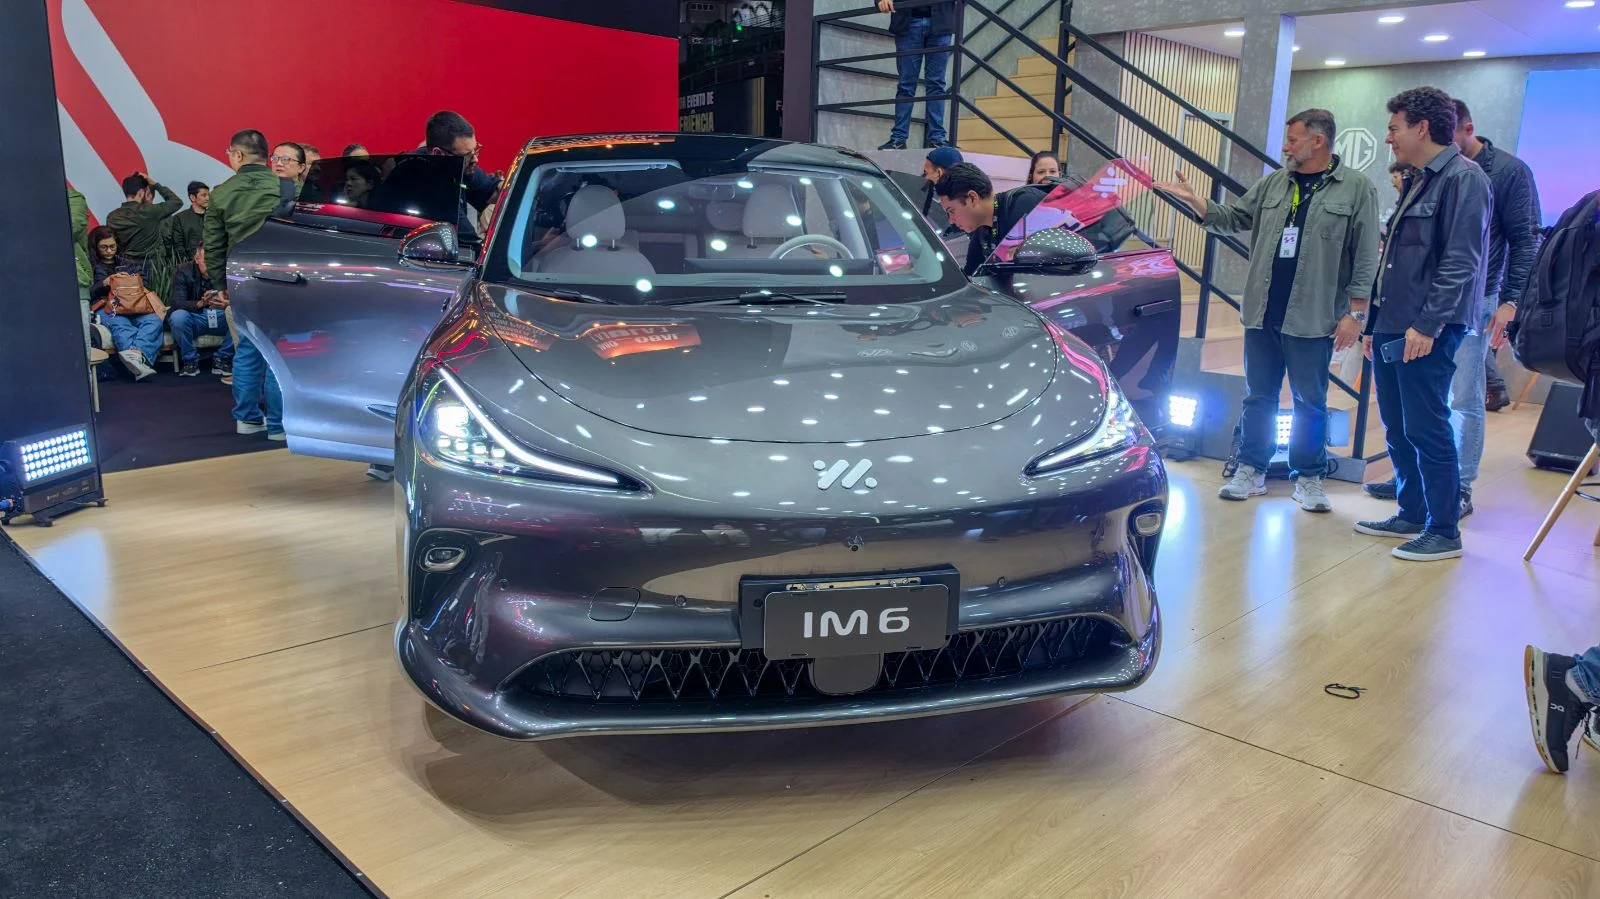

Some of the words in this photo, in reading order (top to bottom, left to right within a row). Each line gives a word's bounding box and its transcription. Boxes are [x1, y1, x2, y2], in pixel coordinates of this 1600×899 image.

[687, 92, 705, 108] EVENTO
[707, 91, 714, 105] DE
[680, 109, 714, 132] ERIÊNCIA
[1334, 130, 1373, 170] MG
[804, 609, 868, 638] IM
[879, 607, 910, 633] 6
